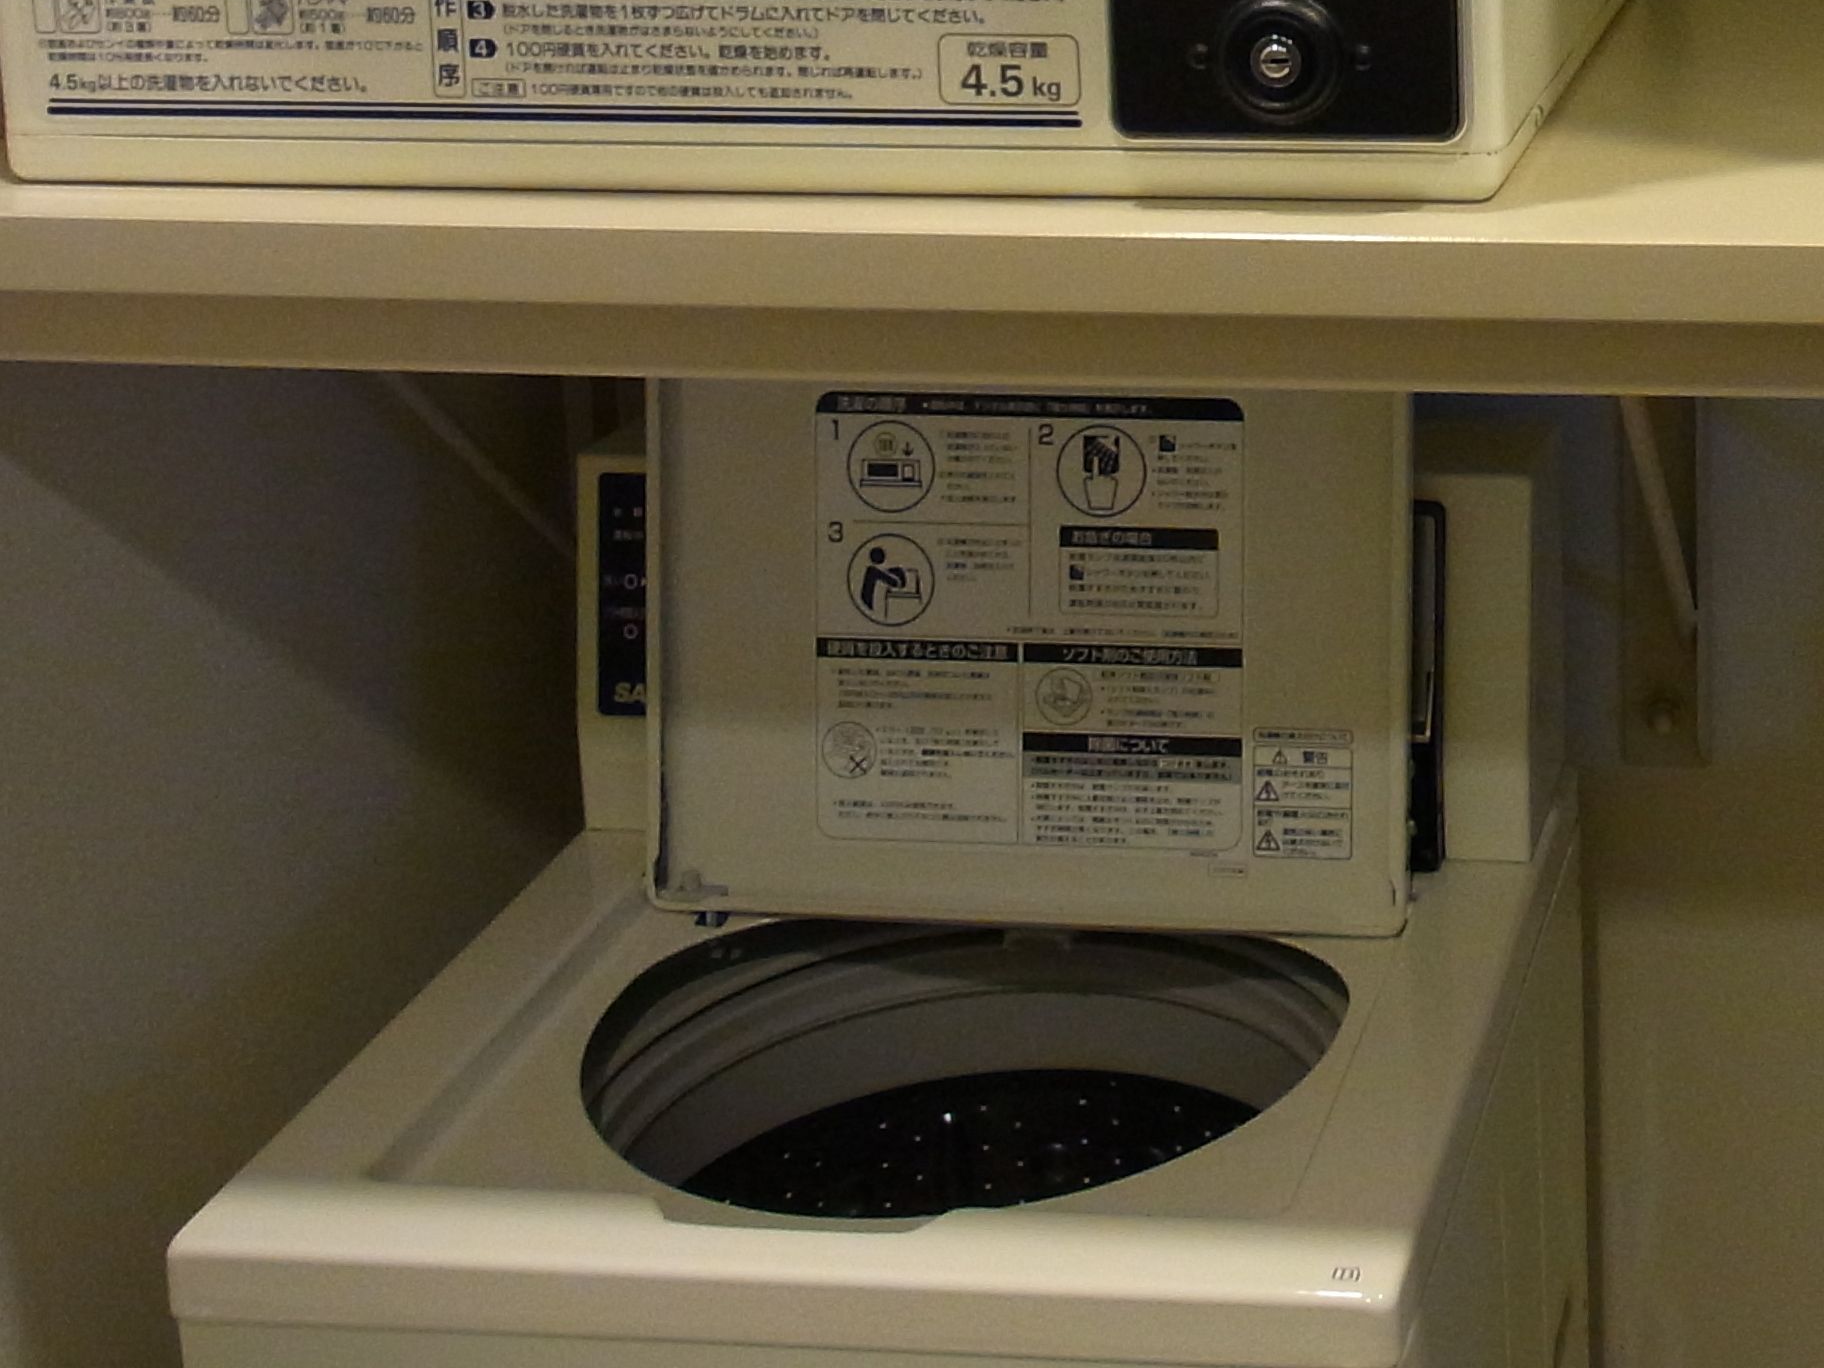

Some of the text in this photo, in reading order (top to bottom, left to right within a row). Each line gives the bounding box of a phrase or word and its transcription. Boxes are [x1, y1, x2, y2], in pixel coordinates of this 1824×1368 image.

[961, 64, 1062, 101] 4.5 kg
[1039, 424, 1054, 445] 2
[828, 522, 843, 542] 3
